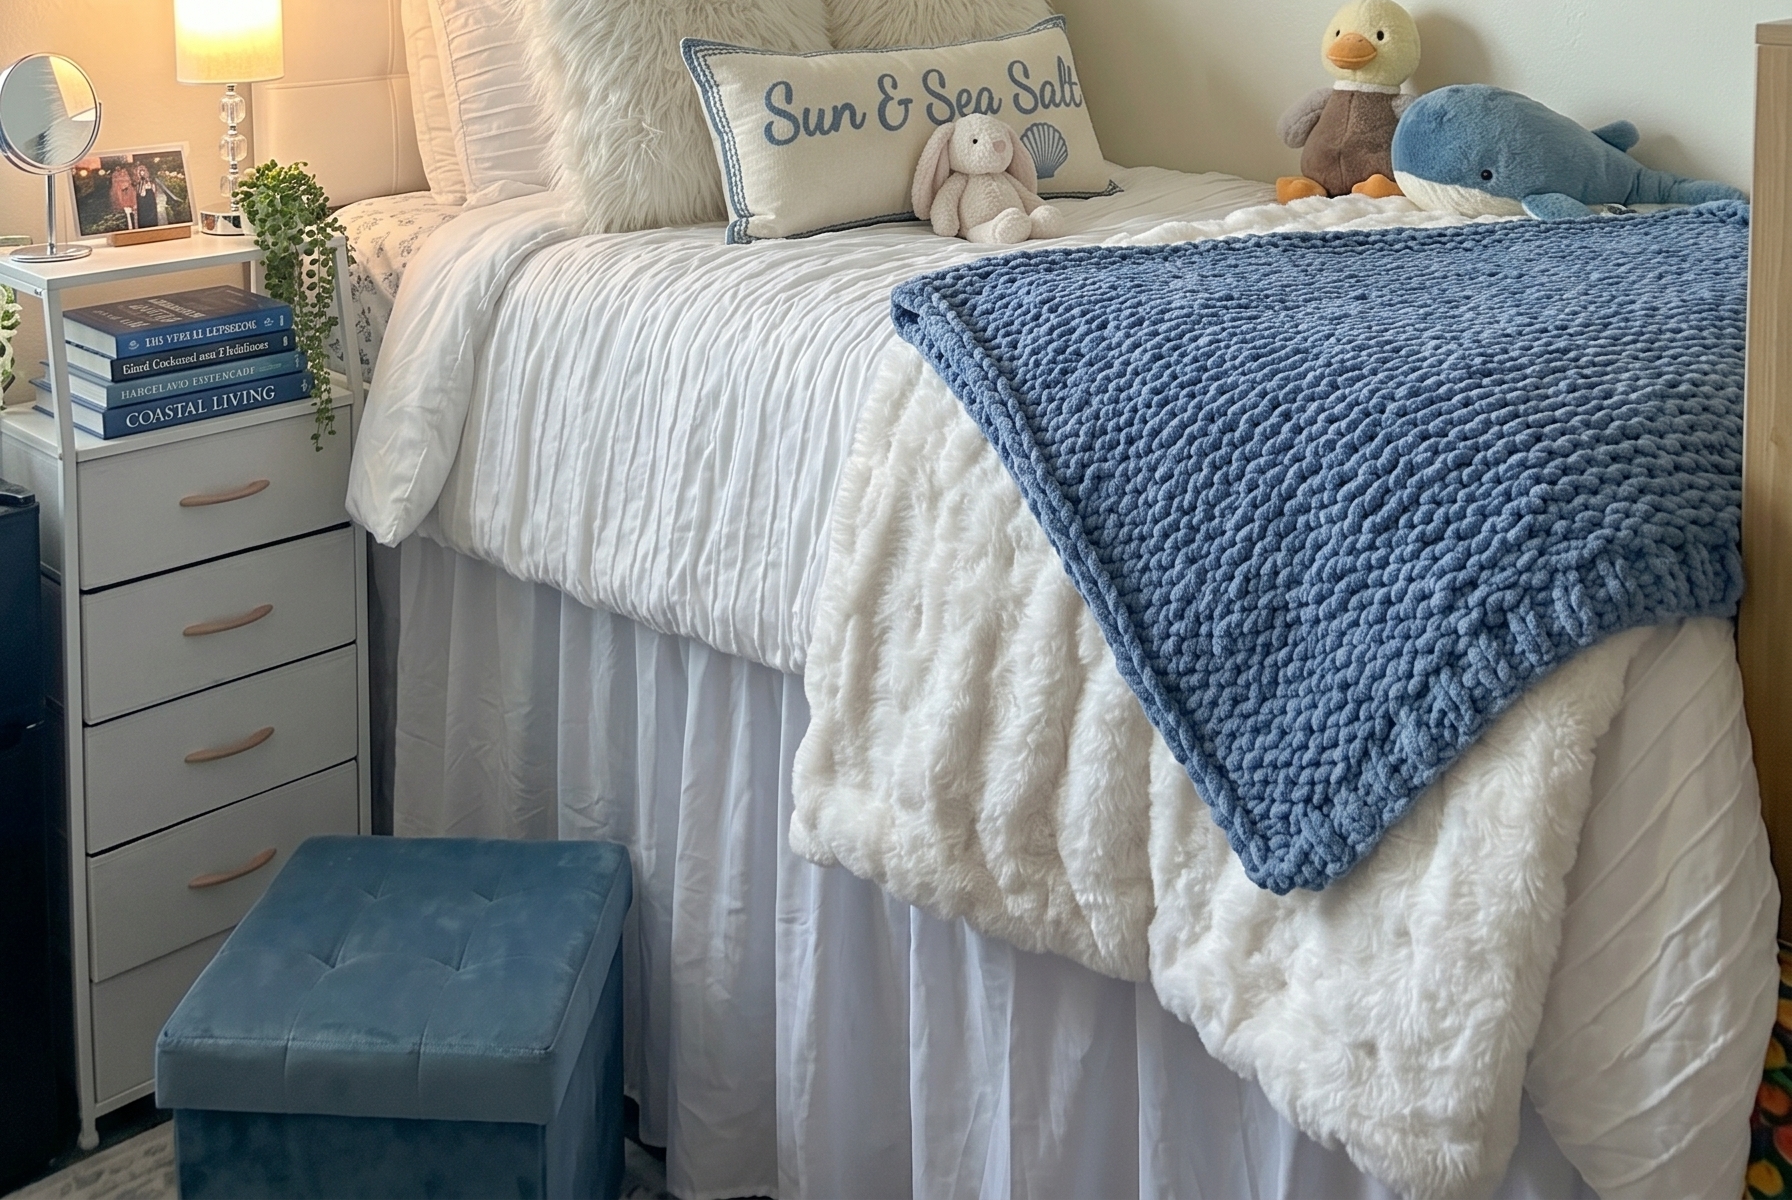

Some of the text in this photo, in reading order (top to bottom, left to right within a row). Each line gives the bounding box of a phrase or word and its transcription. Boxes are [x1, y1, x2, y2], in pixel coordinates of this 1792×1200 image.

[763, 54, 1083, 147] Sun & Sea Salt
[125, 385, 276, 428] COASTAL LIVING
